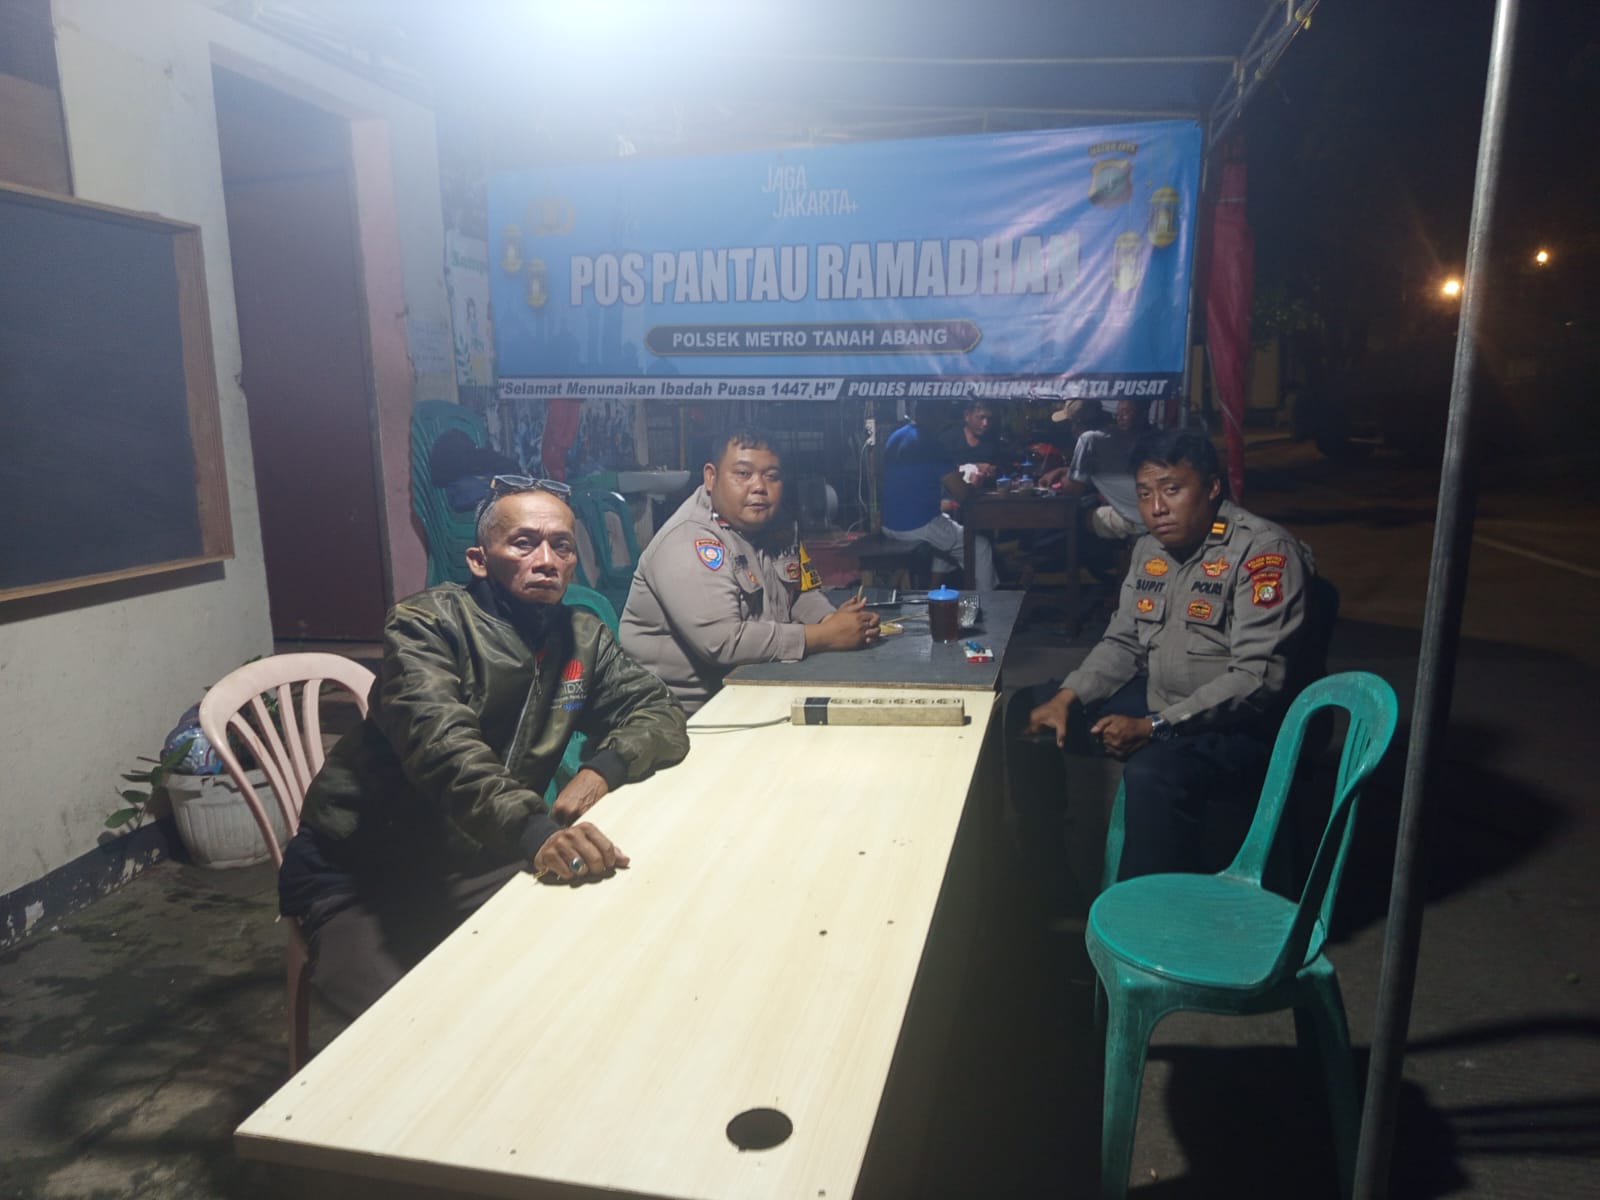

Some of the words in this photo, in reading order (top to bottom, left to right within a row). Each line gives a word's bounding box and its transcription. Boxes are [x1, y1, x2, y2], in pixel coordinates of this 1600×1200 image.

[761, 164, 807, 192] JAGA
[570, 252, 646, 307] POS
[651, 245, 809, 305] PANTAU
[816, 234, 1081, 299] RAMADHAN
[672, 332, 739, 348] POLSEK
[745, 331, 807, 348] METRO
[813, 330, 875, 347] TANAH
[880, 328, 947, 345] ABANG
[566, 381, 655, 396] Menunaikan
[661, 381, 712, 396] Ibadah
[717, 381, 766, 396] Puasa
[848, 381, 905, 396] POLRES
[1112, 380, 1168, 396] PUSAT
[1136, 579, 1165, 592] SUPIT
